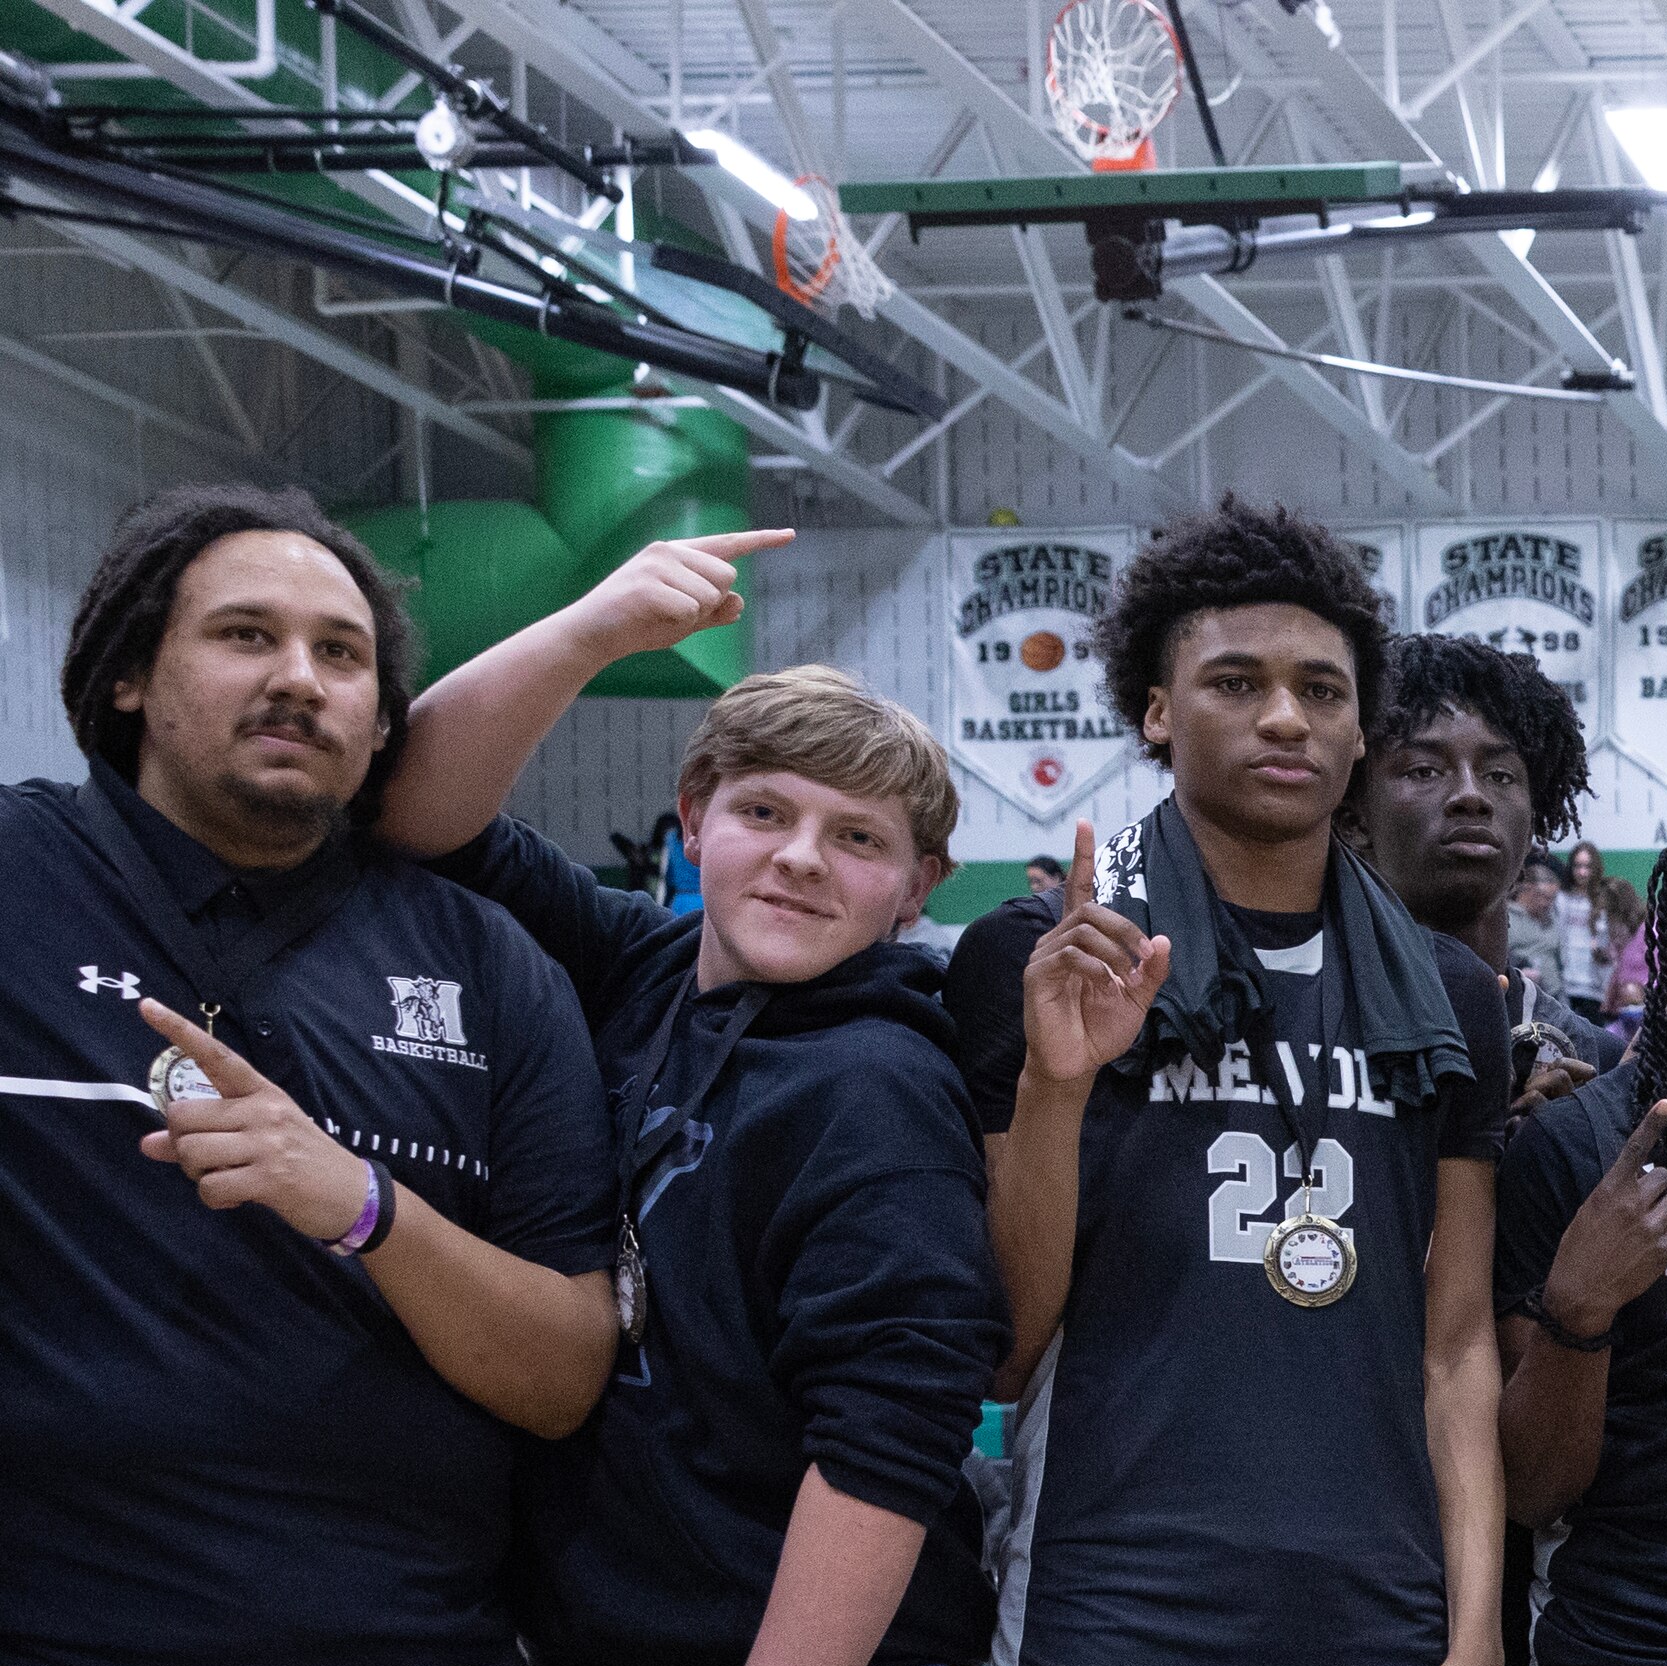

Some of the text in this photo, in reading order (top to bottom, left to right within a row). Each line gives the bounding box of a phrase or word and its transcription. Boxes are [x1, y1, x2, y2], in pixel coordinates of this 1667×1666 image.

[977, 543, 1112, 582] STATE
[1443, 532, 1581, 576] STATE
[959, 576, 1107, 638] CHAMPION
[1424, 564, 1595, 628] CHAMPIONS
[977, 641, 1012, 663] 19
[1008, 690, 1081, 713] GIRLS
[371, 1035, 489, 1071] BASKETBALL
[1207, 1131, 1355, 1265] 22
